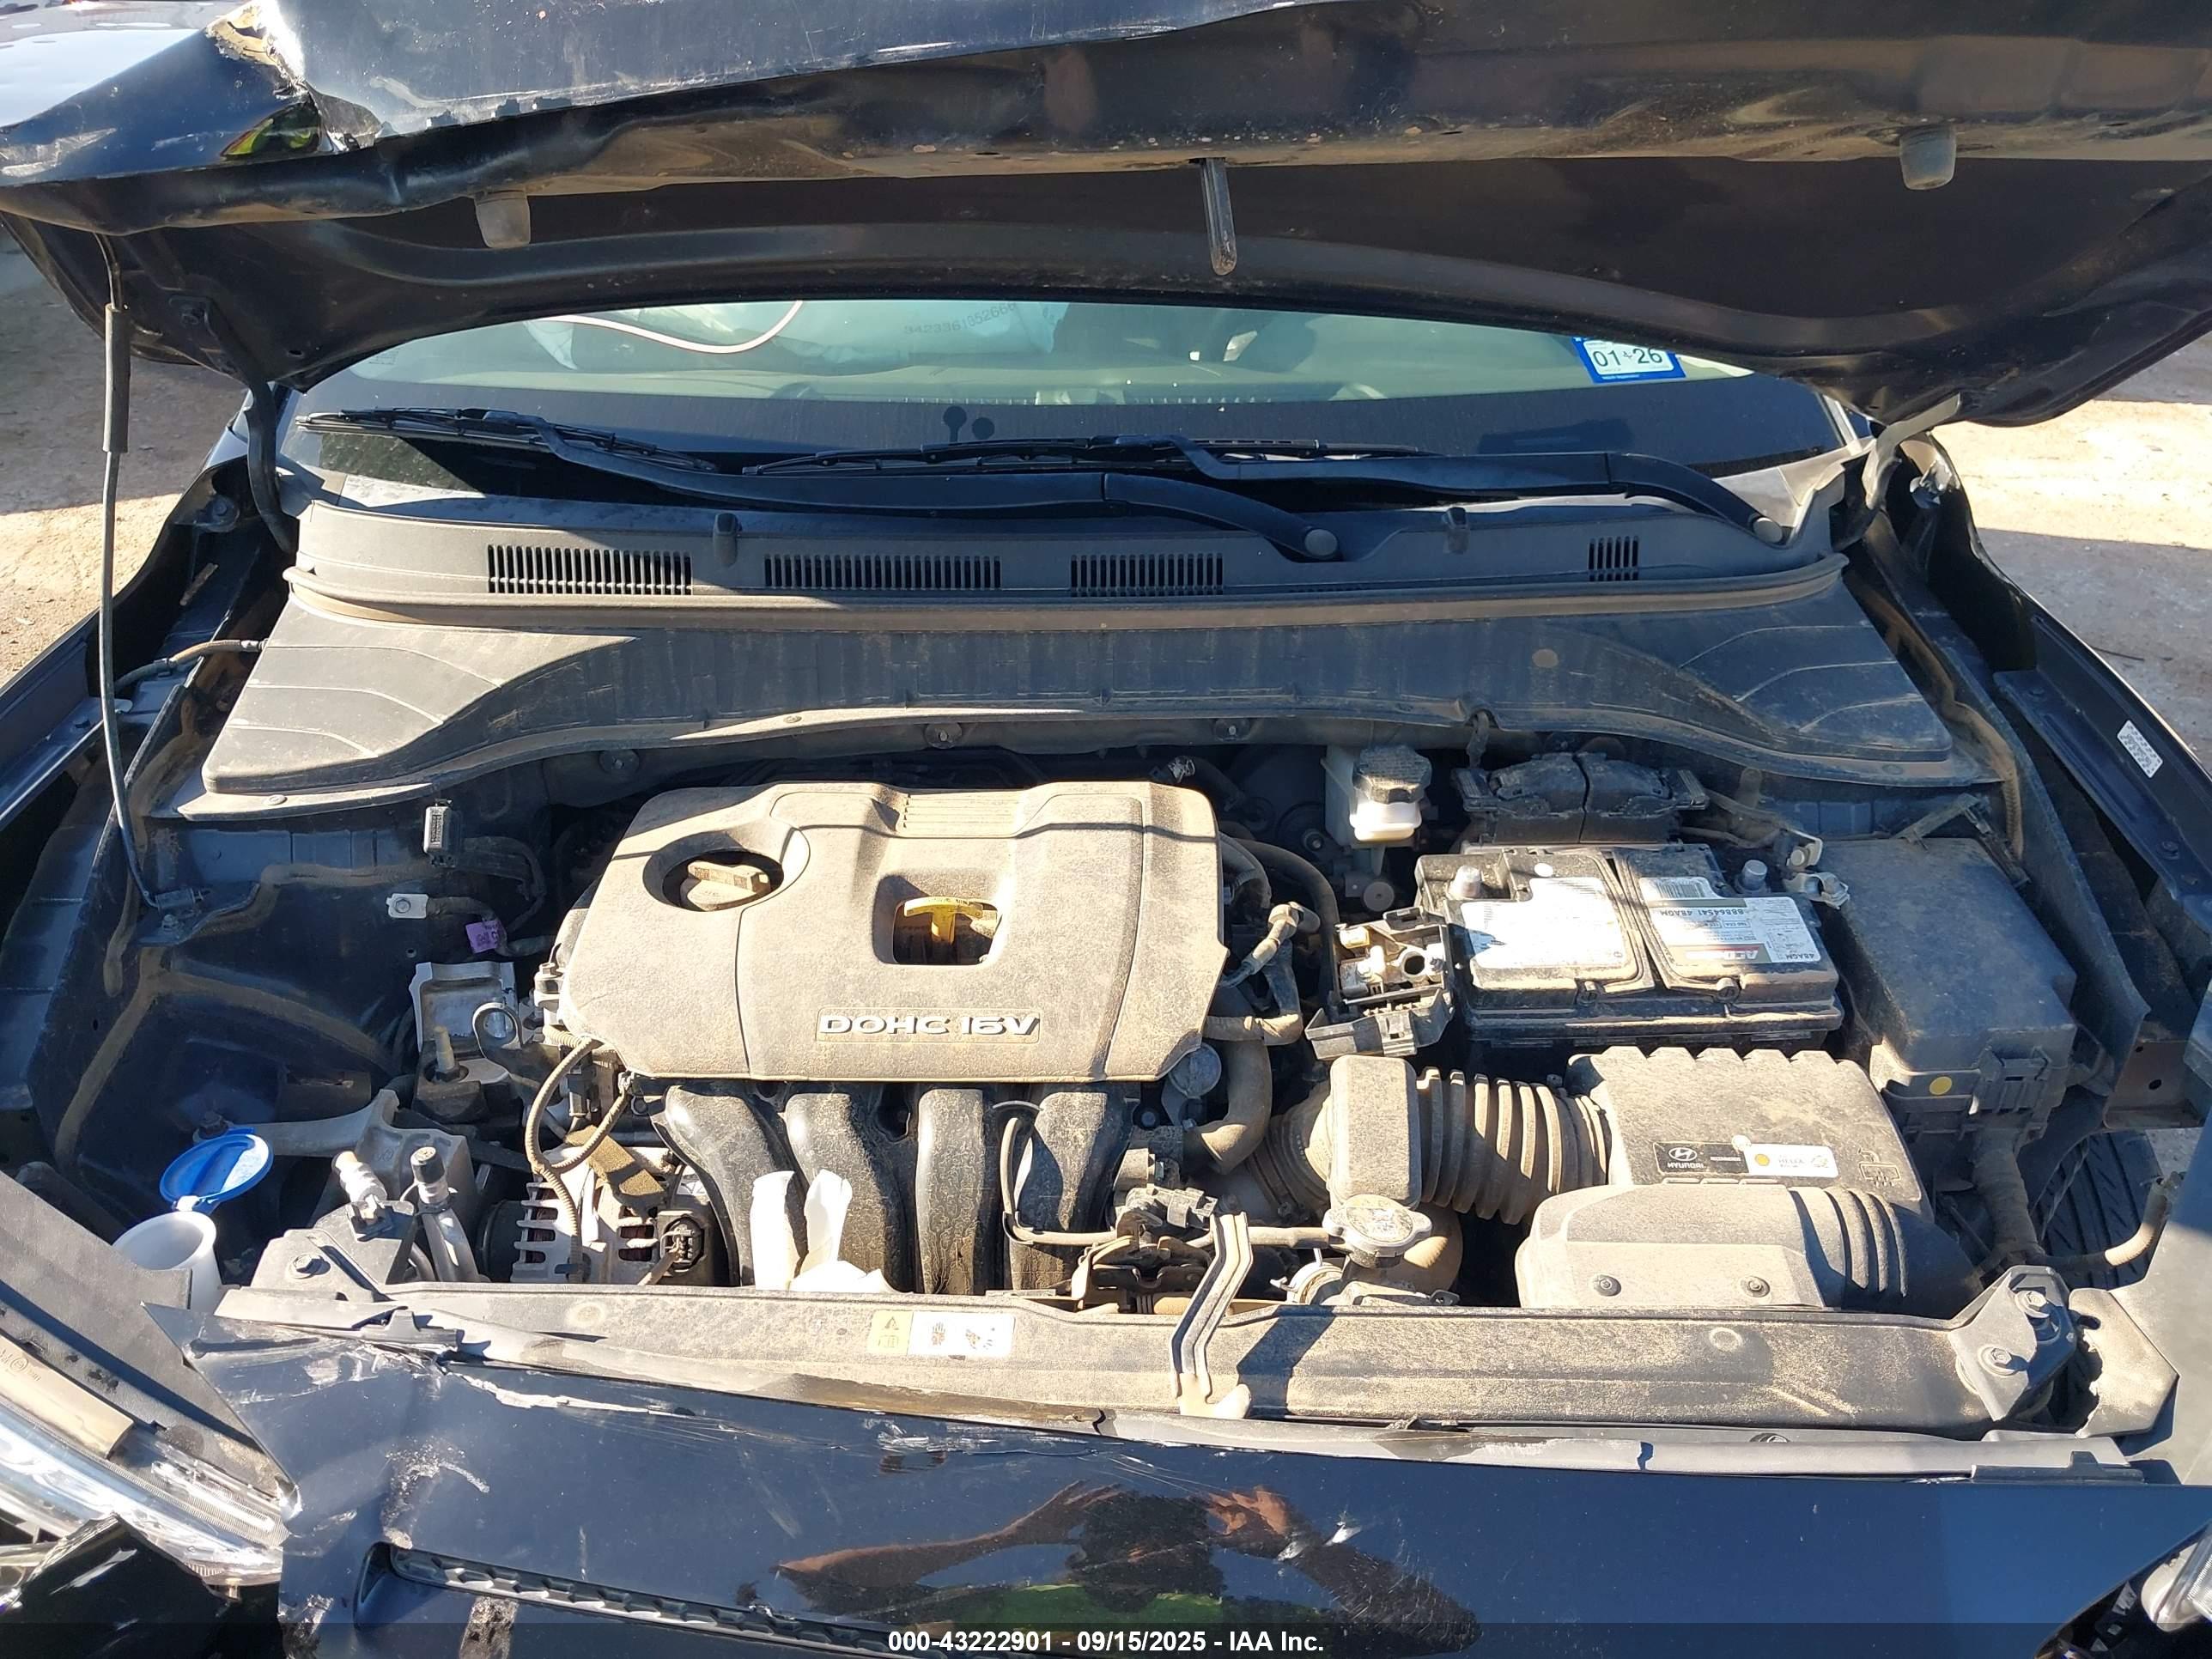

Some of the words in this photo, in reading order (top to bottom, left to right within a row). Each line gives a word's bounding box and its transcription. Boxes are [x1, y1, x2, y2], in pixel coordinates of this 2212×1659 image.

[1592, 350, 1621, 367] 01
[1632, 348, 1662, 364] 26
[818, 1016, 951, 1035] DOHC
[961, 1016, 1041, 1035] 16V
